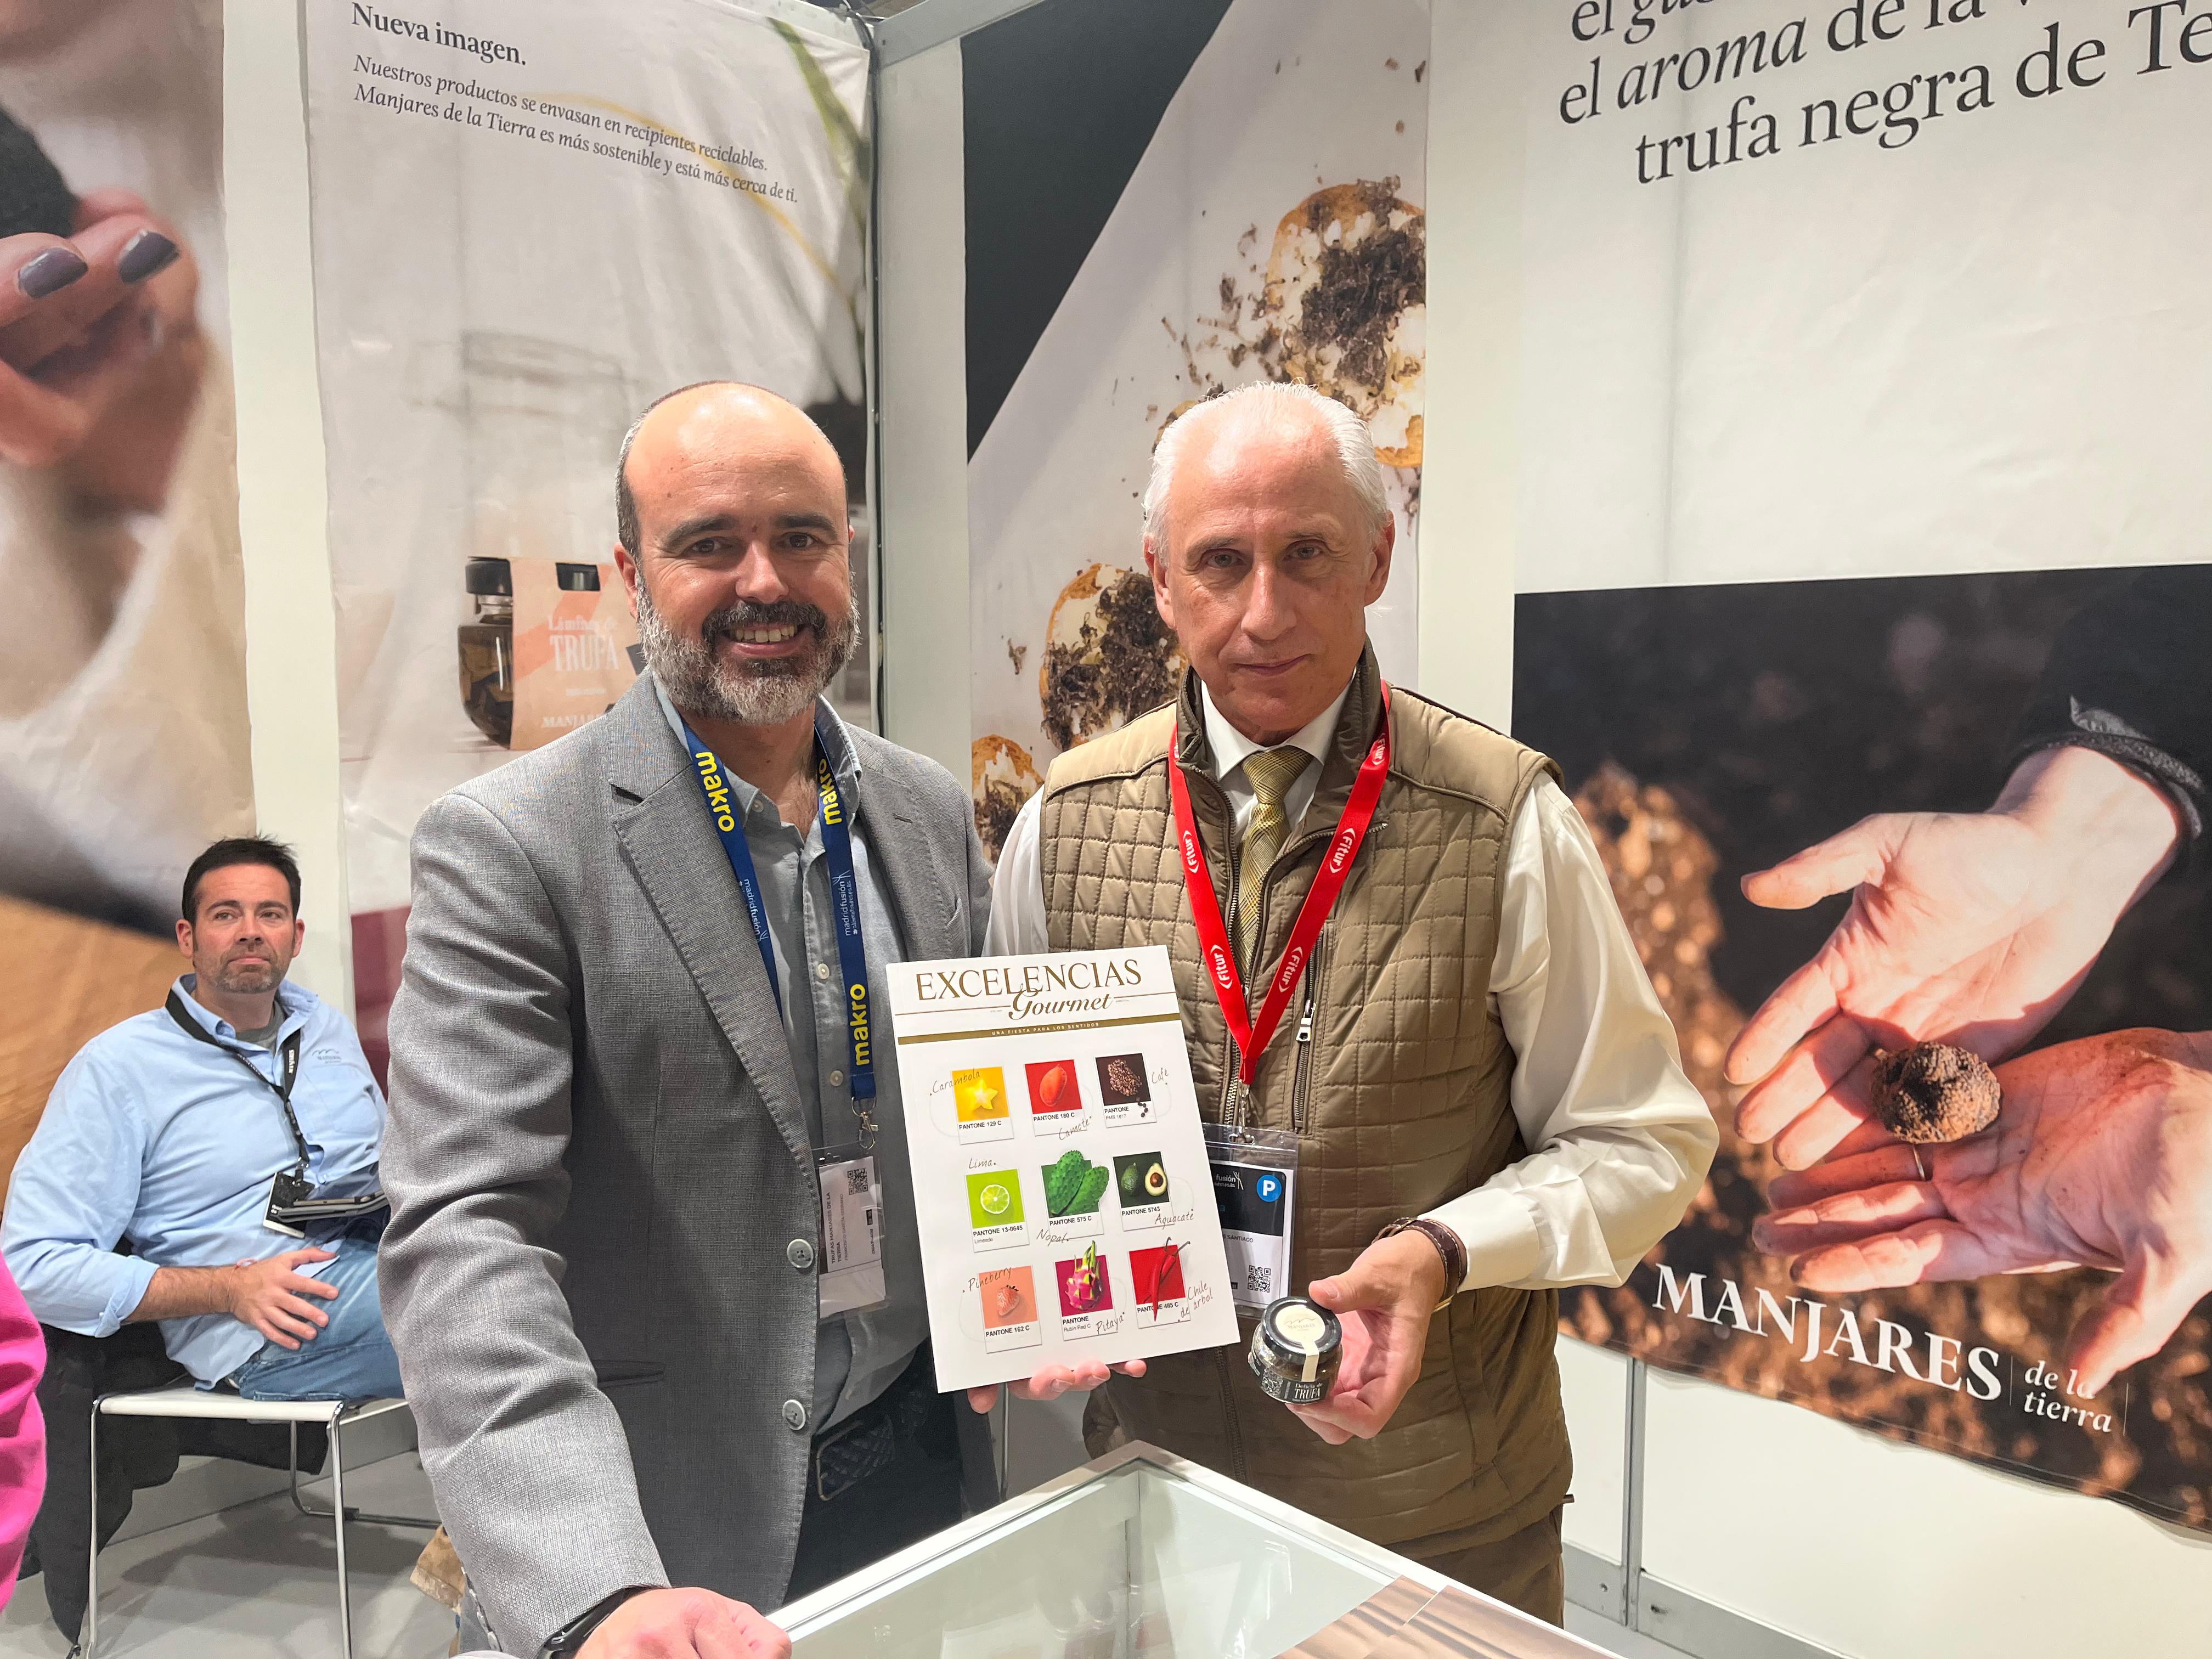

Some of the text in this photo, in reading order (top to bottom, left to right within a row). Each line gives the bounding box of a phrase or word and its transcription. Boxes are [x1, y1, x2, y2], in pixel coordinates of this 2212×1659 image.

[352, 2, 526, 65] Nueva imagen.
[1560, 55, 1601, 123] el
[1617, 16, 1808, 109] aroma
[1827, 0, 1906, 52] de
[353, 55, 767, 171] Nuestros productos se envasan en recipientes reciclables.
[1635, 95, 1780, 184] trufa
[1798, 65, 1995, 149] negra
[2016, 21, 2106, 98] de
[354, 83, 798, 202] Manjares de la Tierra es más sostenible y está más cerca de ti.
[695, 752, 735, 832] makro
[819, 758, 842, 825] makro
[743, 878, 761, 935] madridfusión
[838, 881, 851, 936] madridfusión
[916, 958, 1142, 1001] EXCELENCIAS
[1008, 983, 1114, 1020] Gourmet
[850, 984, 870, 1066] makro
[932, 1068, 981, 1093] Carambola
[959, 1122, 985, 1130] PANTONE
[1216, 1173, 1236, 1183] fusión
[1262, 1180, 1276, 1197] P
[826, 1192, 831, 1200] LA
[826, 1201, 831, 1209] DE
[1121, 1208, 1147, 1216] PANTONE
[1227, 1234, 1254, 1243] SANTIAGO
[968, 1267, 1012, 1292] Pineberry
[1188, 1279, 1208, 1300] Chile
[1062, 1316, 1089, 1325] PANTONE
[1096, 1314, 1124, 1335] Pitaya
[1181, 1307, 1190, 1318] de
[985, 1328, 1013, 1337] PANTONE
[1652, 1263, 2002, 1401] MANJARES
[1294, 1388, 1321, 1400] TRUFA
[2024, 1360, 2096, 1400] de la
[2024, 1392, 2112, 1433] tierra
